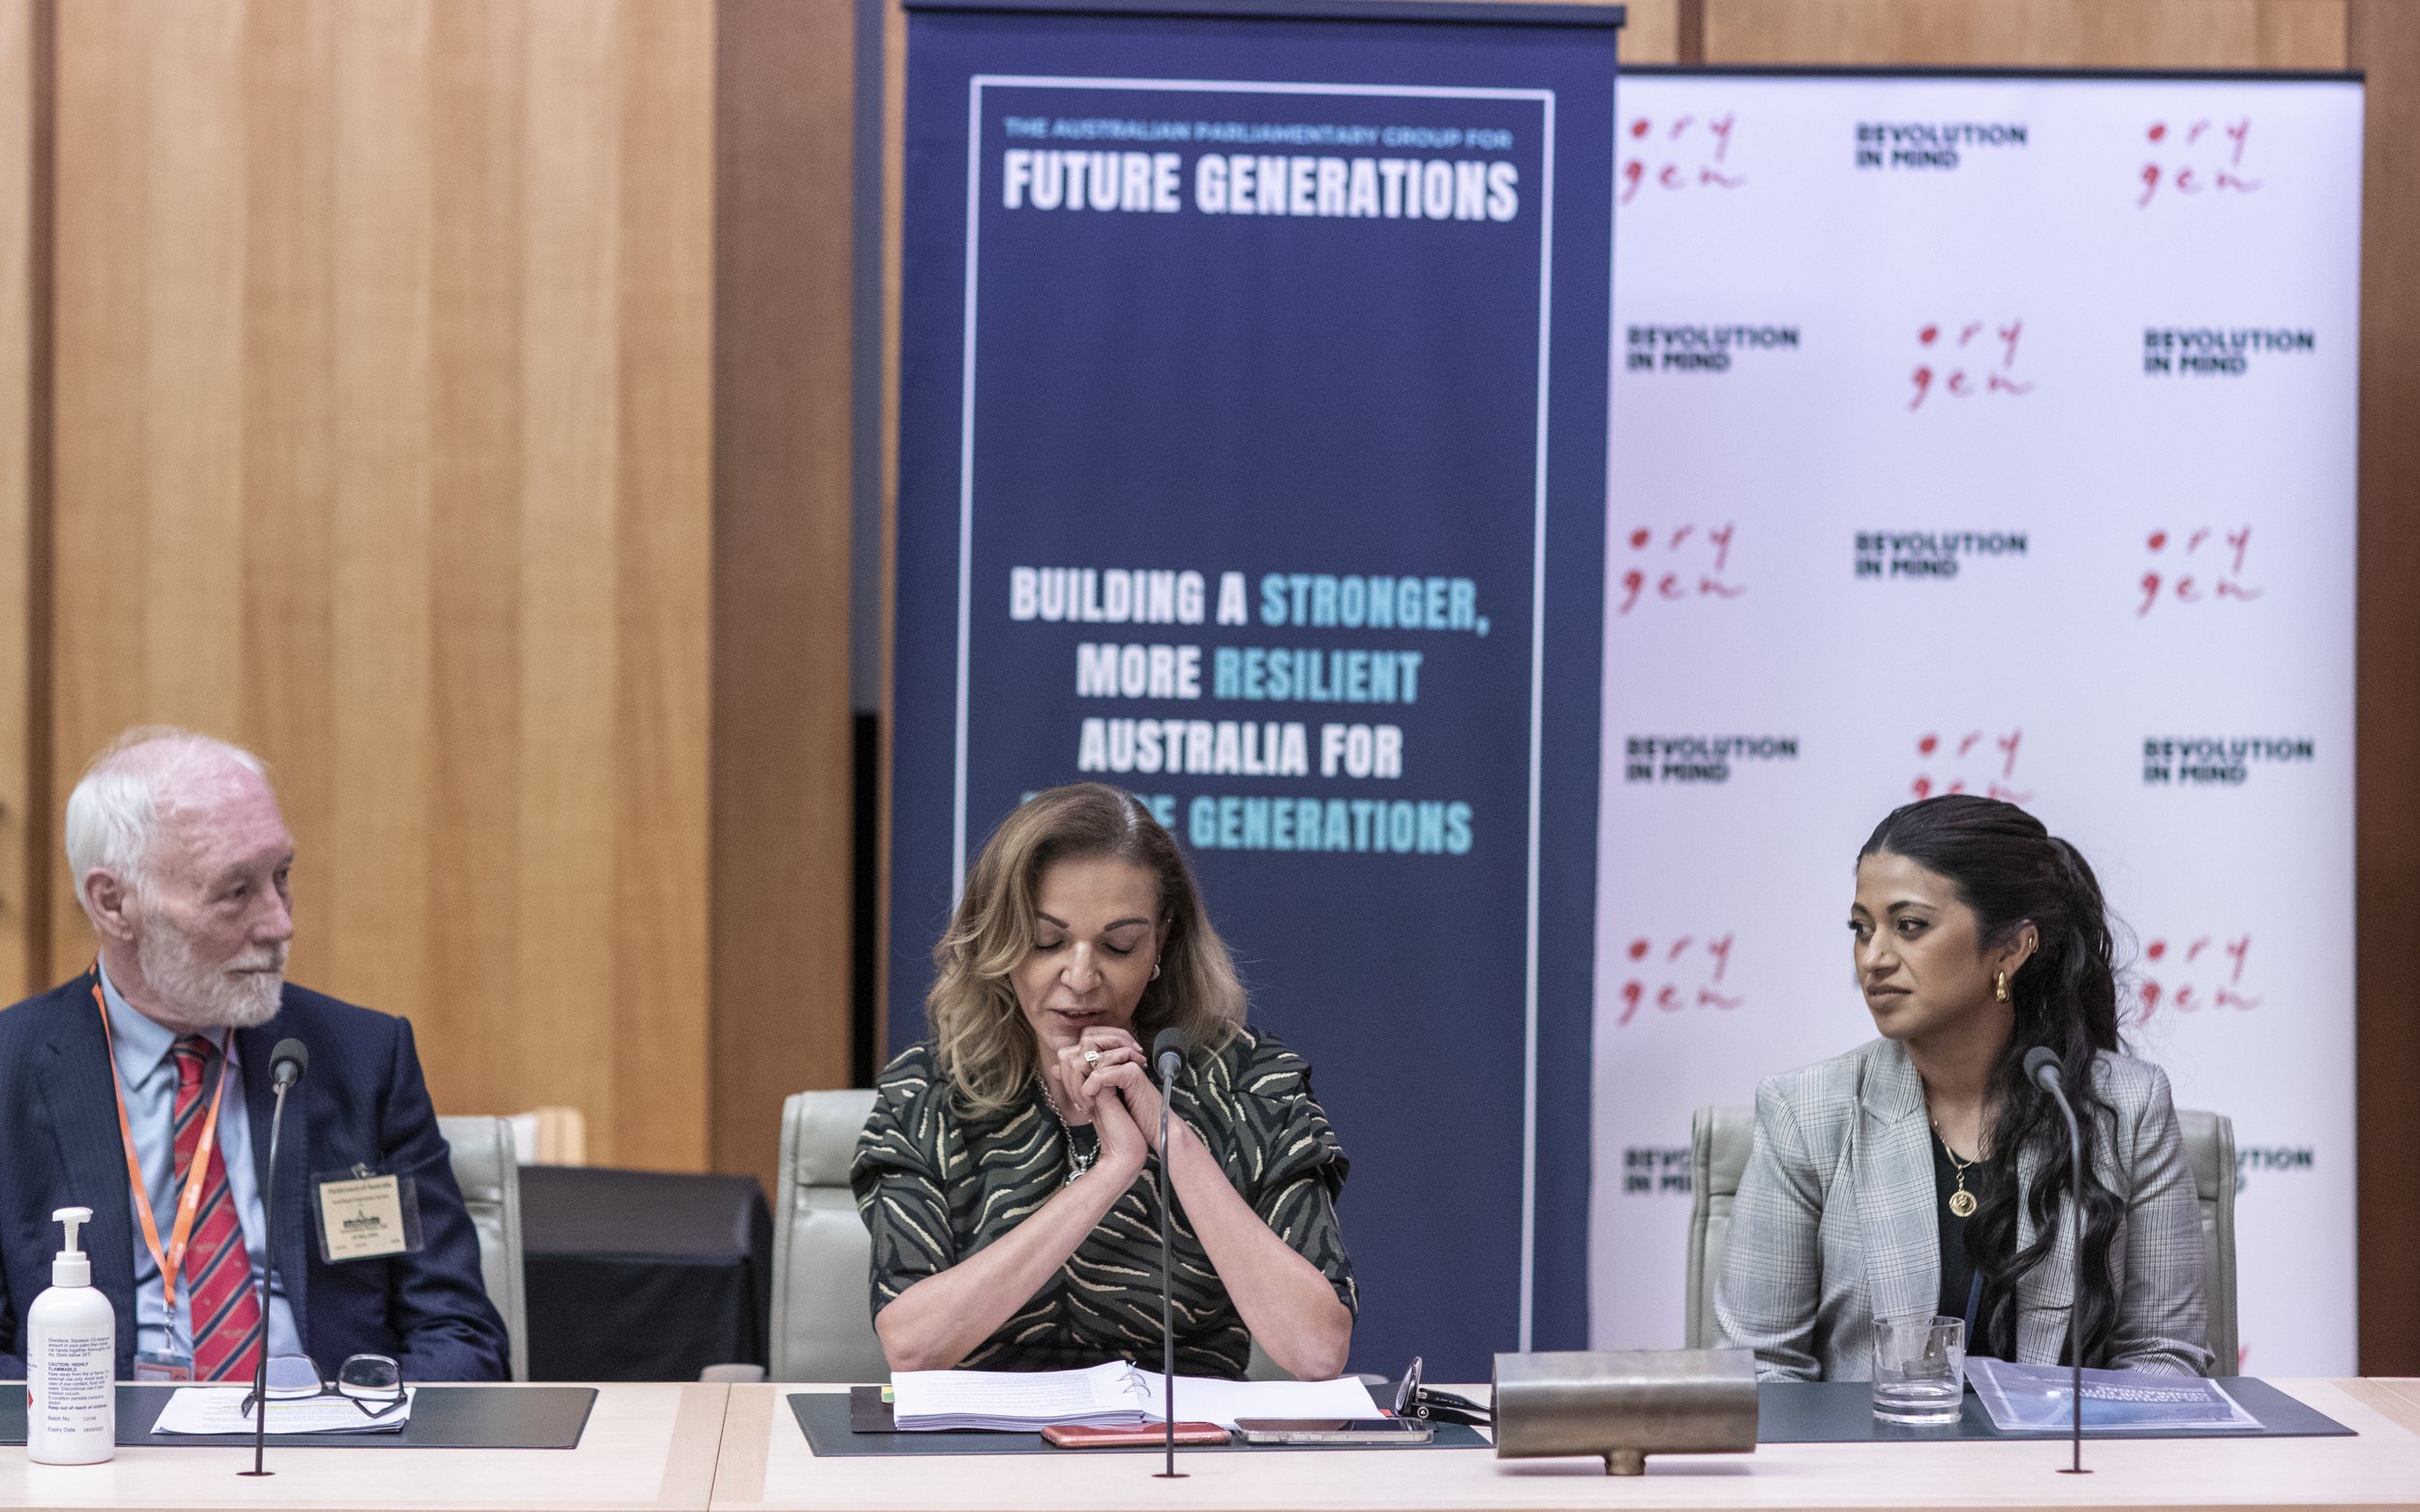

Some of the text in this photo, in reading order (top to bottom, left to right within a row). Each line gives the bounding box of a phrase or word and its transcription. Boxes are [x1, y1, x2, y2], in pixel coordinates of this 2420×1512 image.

[1004, 115, 1514, 151] THE AUSTRALIAN PARLIAMENTARY GROUP FOR
[1856, 123, 2030, 147] REVOLUTION
[1856, 149, 1961, 172] IN MIND
[1003, 148, 1520, 223] FUTURE GENERATIONS
[1621, 160, 1748, 206] gen
[2138, 165, 2265, 211] gen
[1626, 324, 1800, 348] REVOLUTION
[2143, 328, 2317, 352] REVOLUTION
[1626, 350, 1732, 374] IN MIND
[2143, 354, 2249, 378] IN MIND
[1909, 366, 2036, 412] gen
[1856, 530, 2030, 555] REVOLUTION
[1856, 557, 1961, 580] IN MIND
[1010, 566, 1491, 637] BUILDING A STRONGER,
[1620, 568, 1747, 615] gen
[2138, 573, 2265, 620] gen
[1076, 643, 1423, 704] MORE RESILIENT
[1077, 717, 1403, 778] AUSTRALIA FOR
[1625, 735, 1800, 759] REVOLUTION
[2143, 739, 2317, 763] REVOLUTION
[1625, 761, 1731, 784] IN MIND
[2143, 765, 2249, 788] IN MIND
[1189, 796, 1473, 855] GENERATIONS
[1619, 980, 1746, 1026] gen
[2137, 982, 2264, 1028] gen
